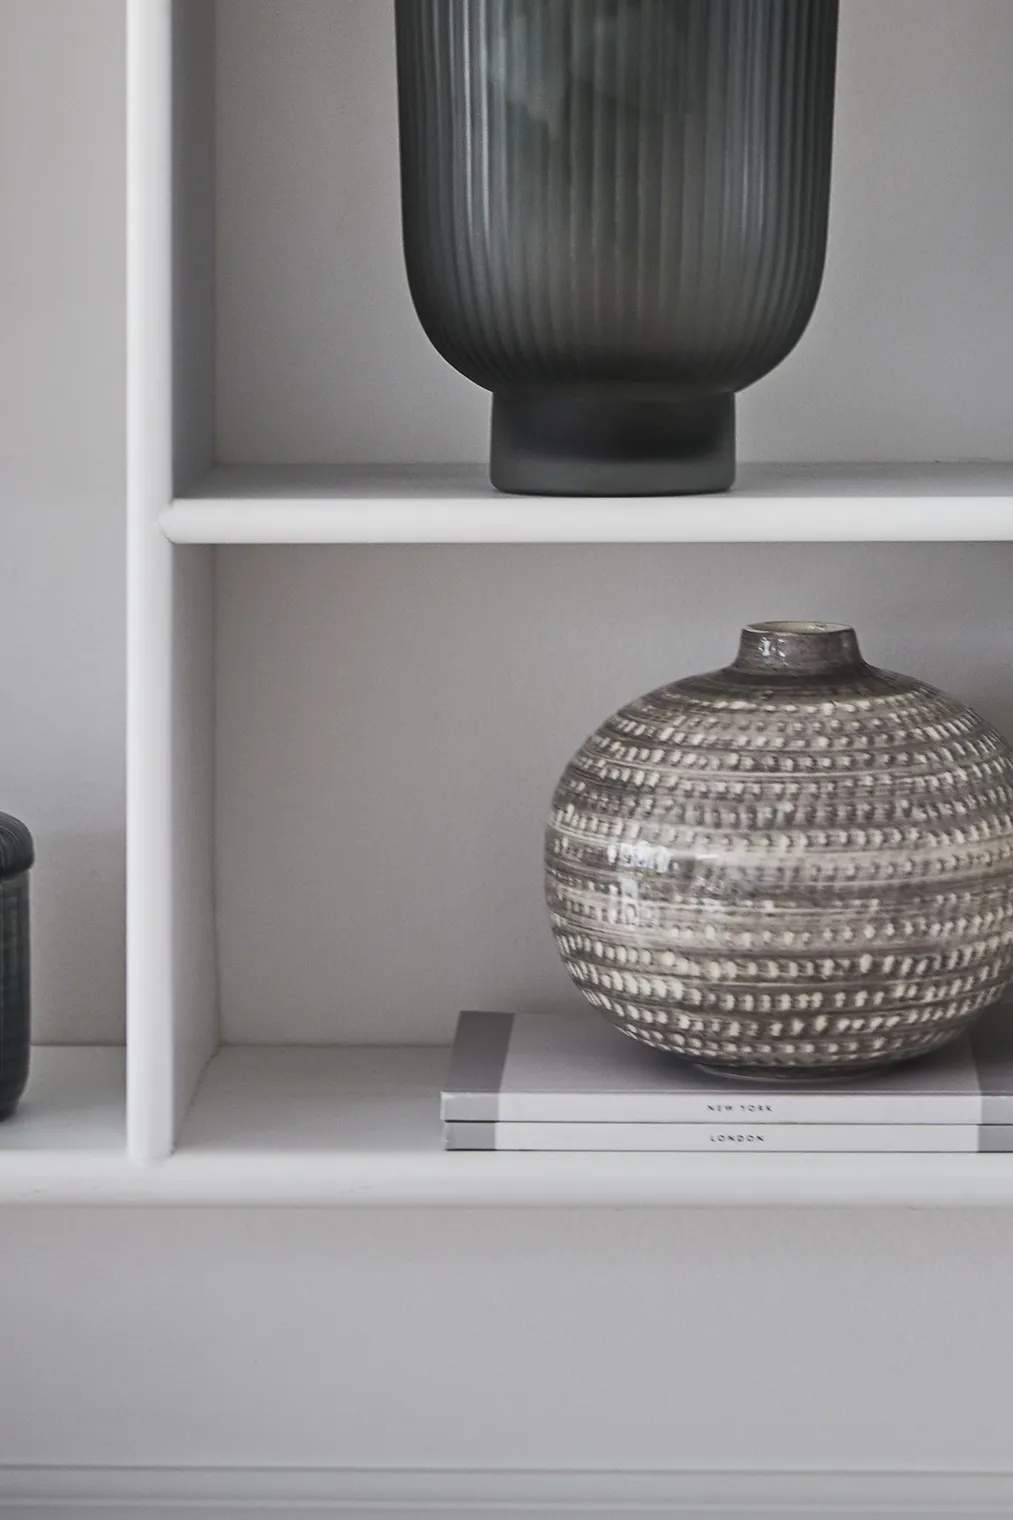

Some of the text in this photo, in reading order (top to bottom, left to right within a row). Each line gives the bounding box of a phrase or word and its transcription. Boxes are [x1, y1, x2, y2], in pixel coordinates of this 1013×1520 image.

[706, 1104, 773, 1112] NEW YORK
[710, 1134, 765, 1142] LONDON
